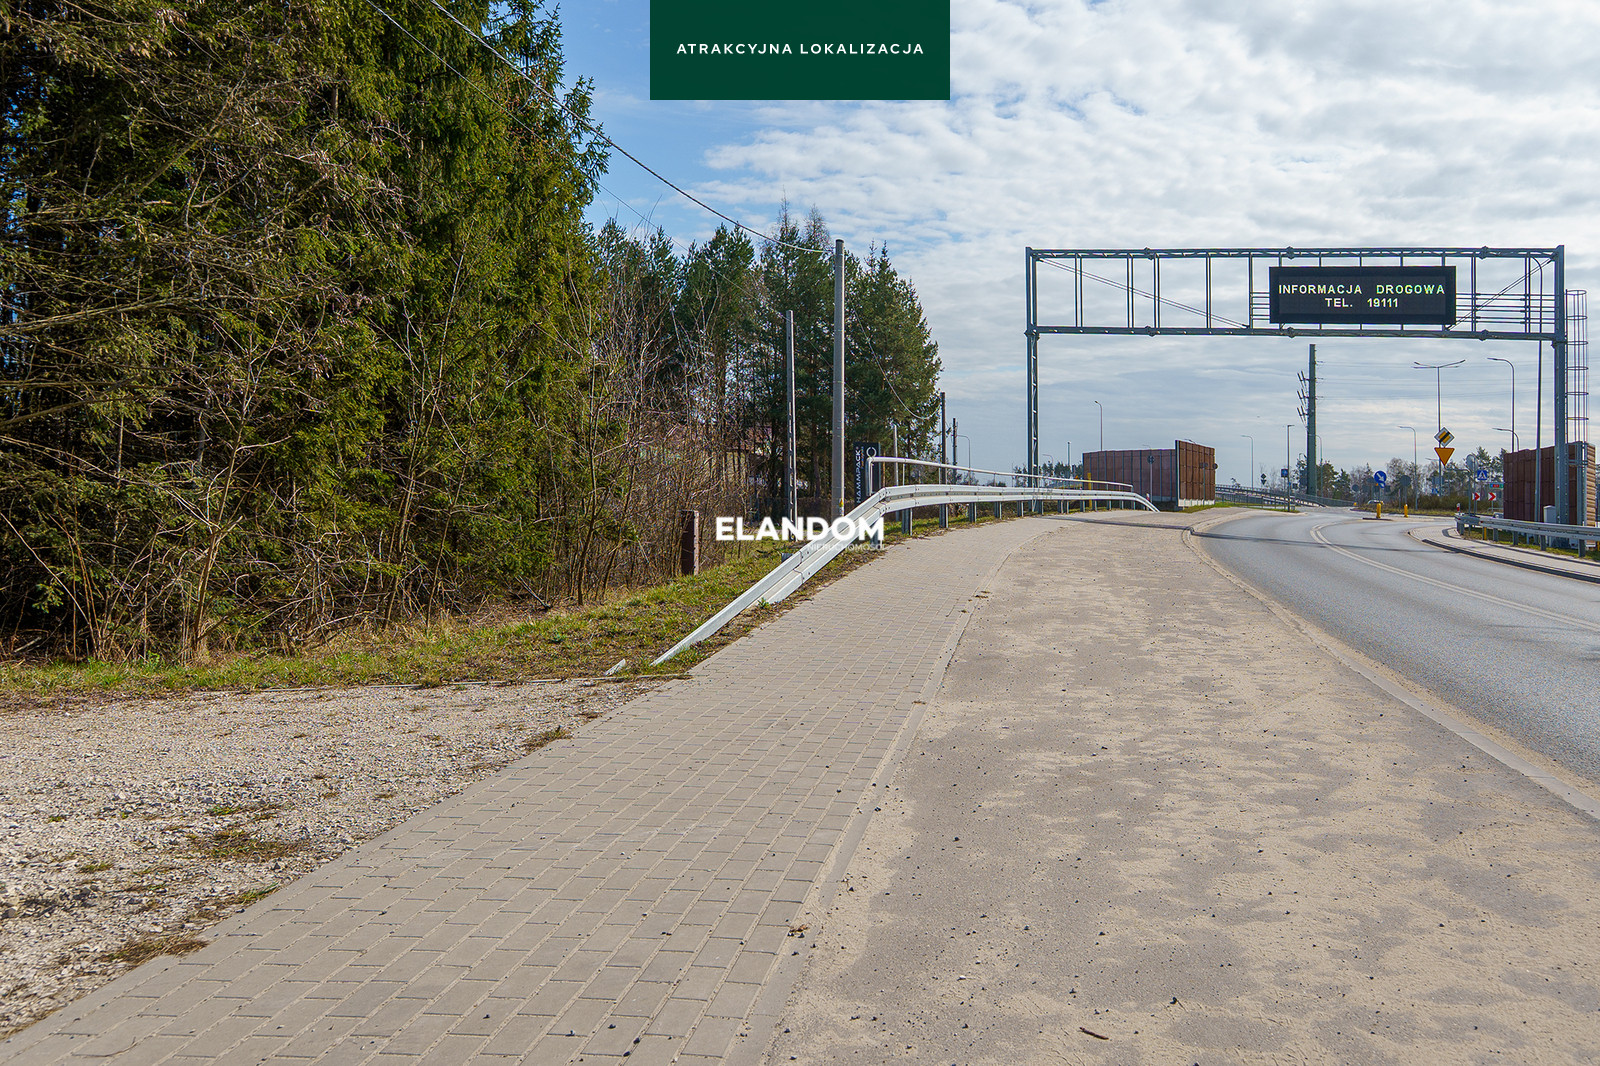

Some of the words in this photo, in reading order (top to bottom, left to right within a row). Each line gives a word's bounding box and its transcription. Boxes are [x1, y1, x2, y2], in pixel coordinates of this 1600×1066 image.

[1278, 284, 1363, 295] INFORMACJA
[1376, 284, 1446, 295] DROGOWA
[1325, 298, 1353, 308] TEL.
[1367, 298, 1399, 308] 19111
